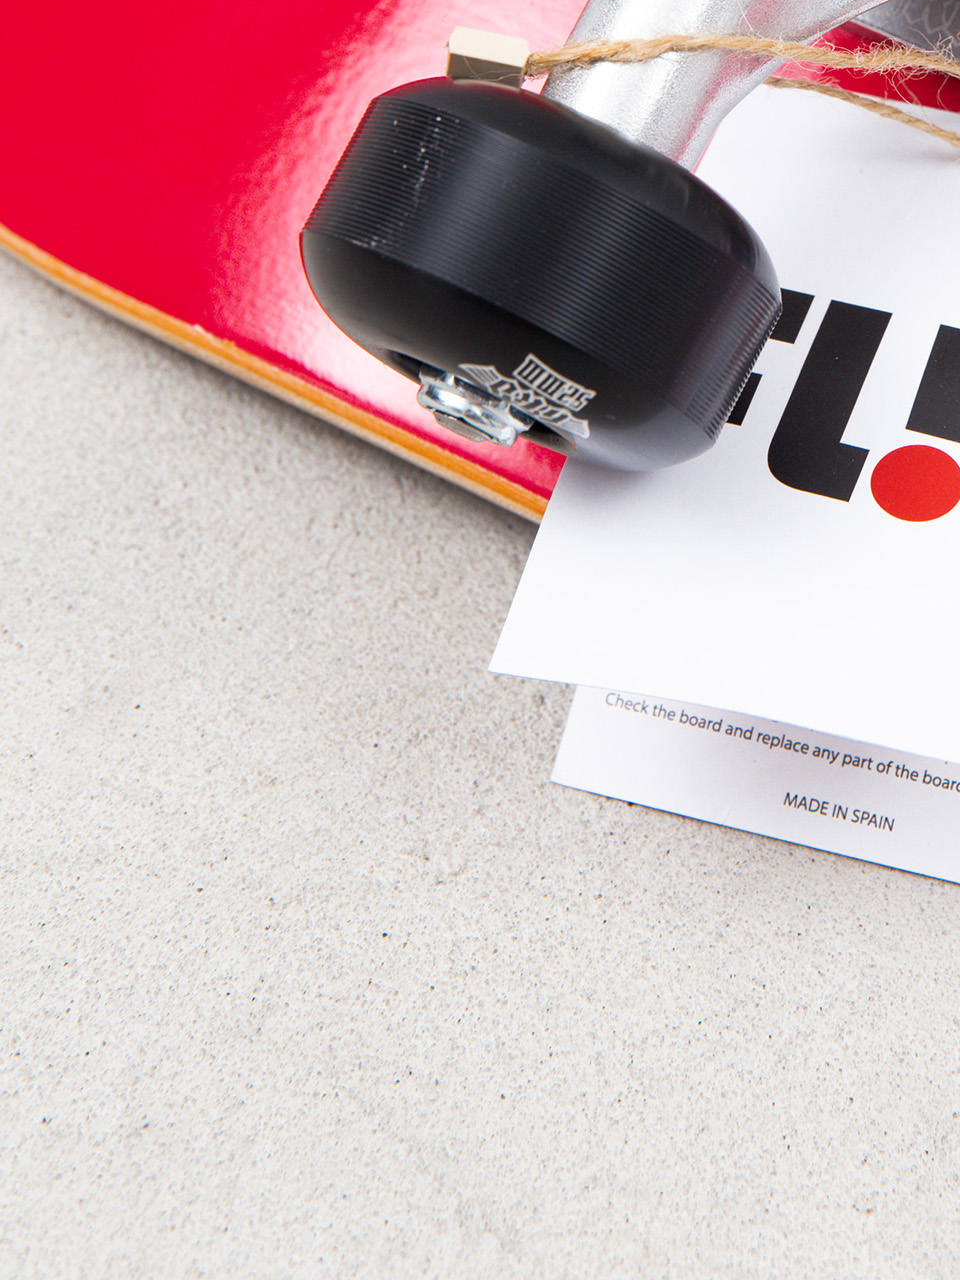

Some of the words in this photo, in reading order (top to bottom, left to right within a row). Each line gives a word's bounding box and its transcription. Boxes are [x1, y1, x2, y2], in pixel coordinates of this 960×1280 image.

[605, 692, 650, 716] Check
[652, 703, 676, 721] the
[679, 709, 723, 733] board
[725, 726, 754, 741] and
[756, 732, 810, 756] replace
[812, 746, 840, 766] any
[842, 753, 873, 771] part
[876, 760, 894, 774] of
[895, 762, 919, 782] the
[783, 792, 830, 816] MADE
[832, 804, 849, 821] IN
[851, 808, 895, 833] SPAIN
